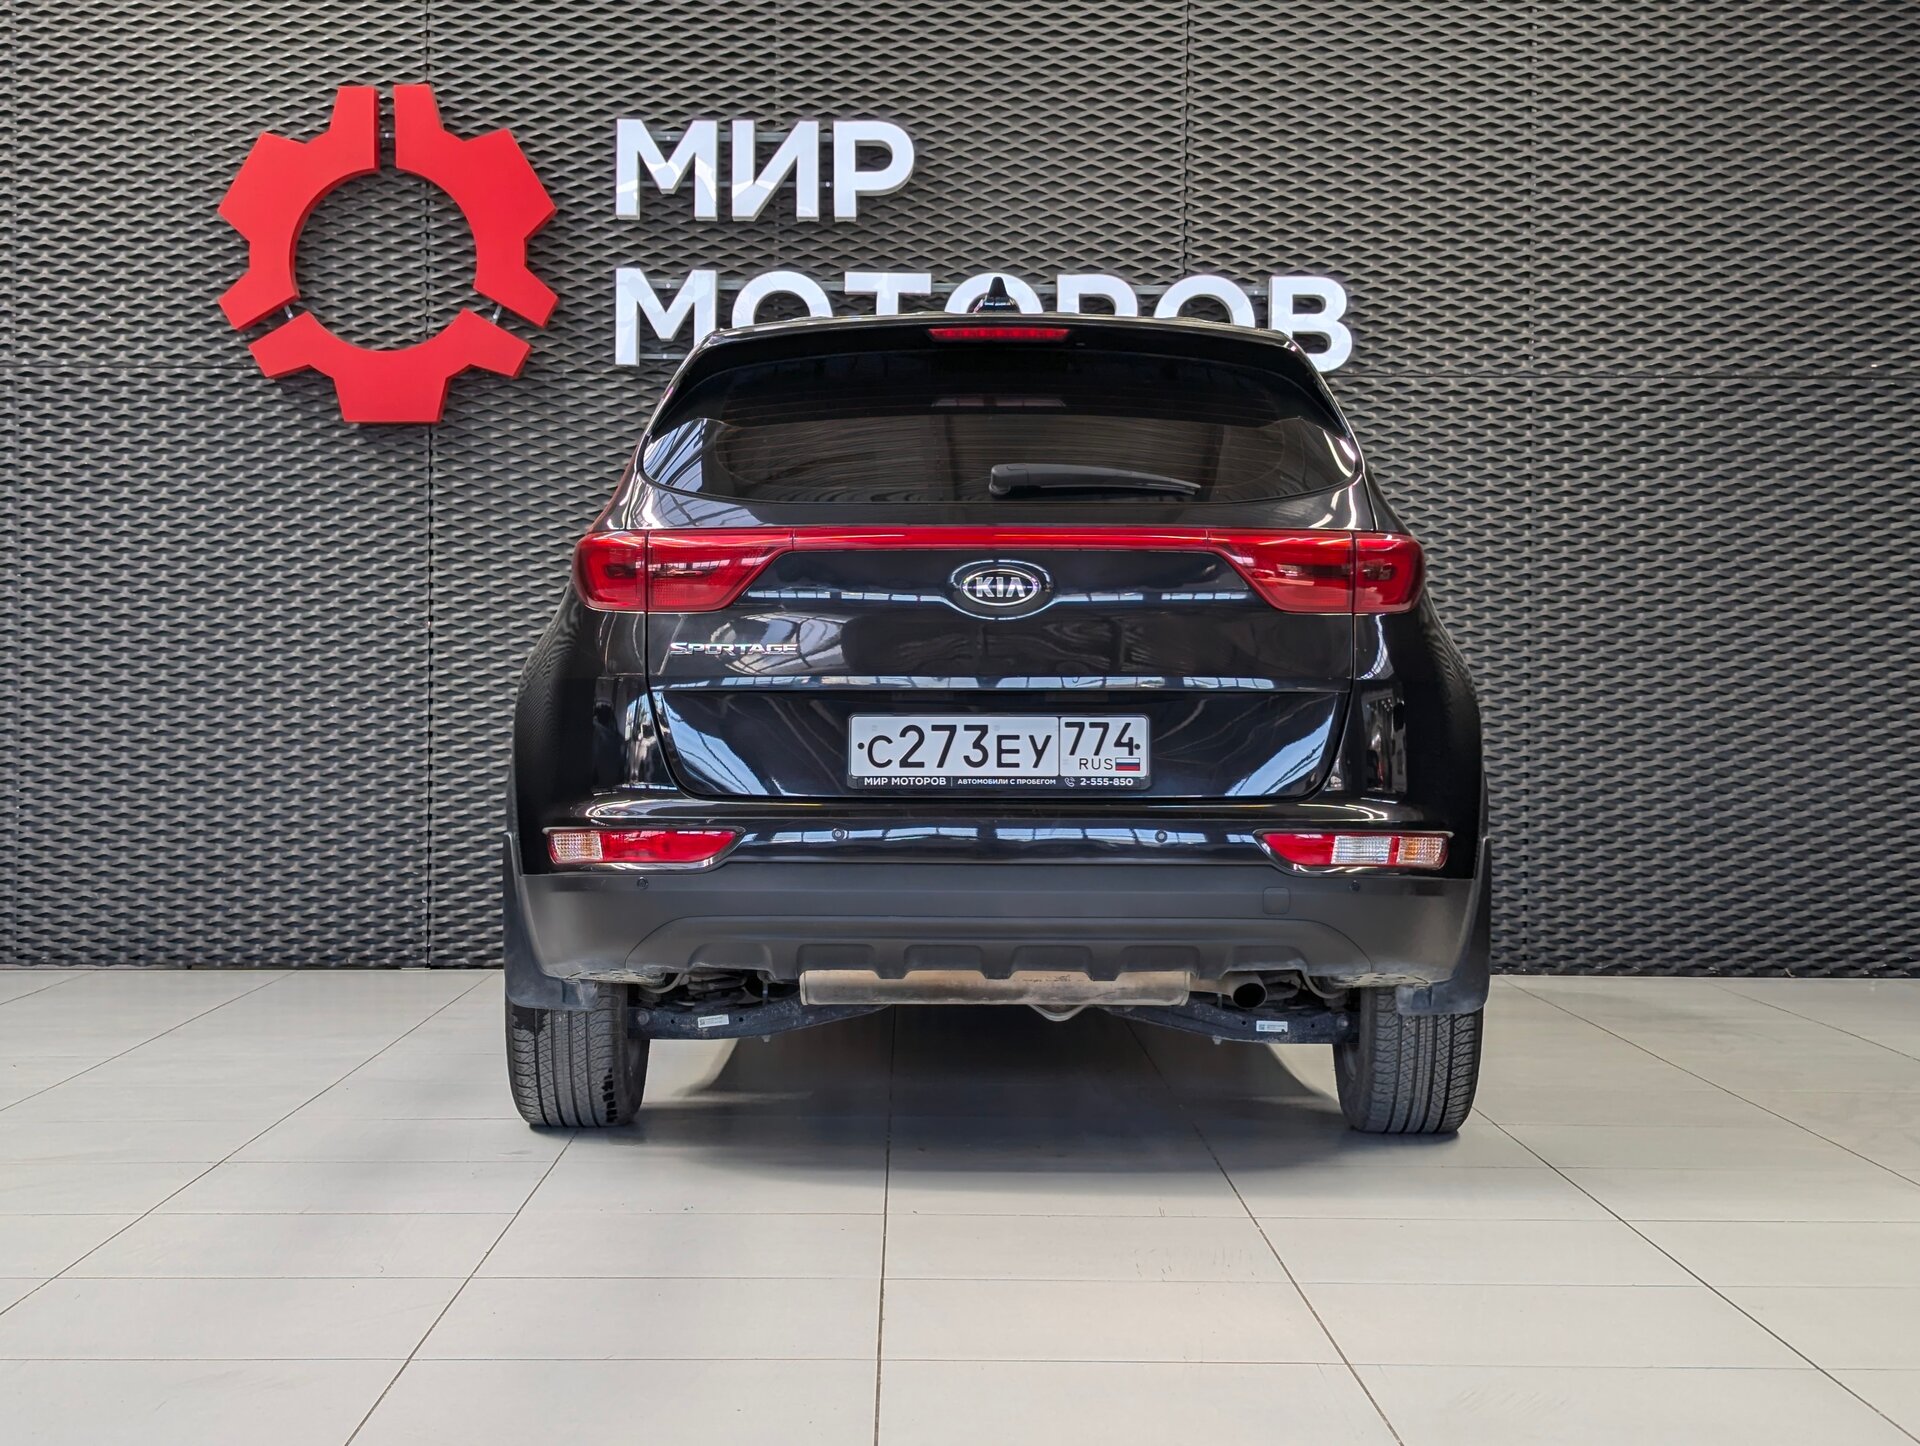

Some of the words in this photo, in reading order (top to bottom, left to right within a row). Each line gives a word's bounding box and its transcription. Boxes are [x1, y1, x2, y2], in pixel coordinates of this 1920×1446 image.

[615, 118, 915, 221] МИР
[976, 576, 1026, 598] KIA
[669, 642, 798, 656] SPORTAGE
[867, 724, 1052, 768] С273ЕУ
[1064, 721, 1134, 756] 774
[1078, 758, 1113, 770] RUS
[864, 776, 888, 786] МИР
[891, 776, 947, 786] МОТОРОВ
[957, 778, 1009, 786] АВТОМОБИЛИ
[1009, 778, 1015, 786] С
[1016, 778, 1056, 786] ПРОБЕГОМ
[1079, 777, 1134, 786] 2-555-850
